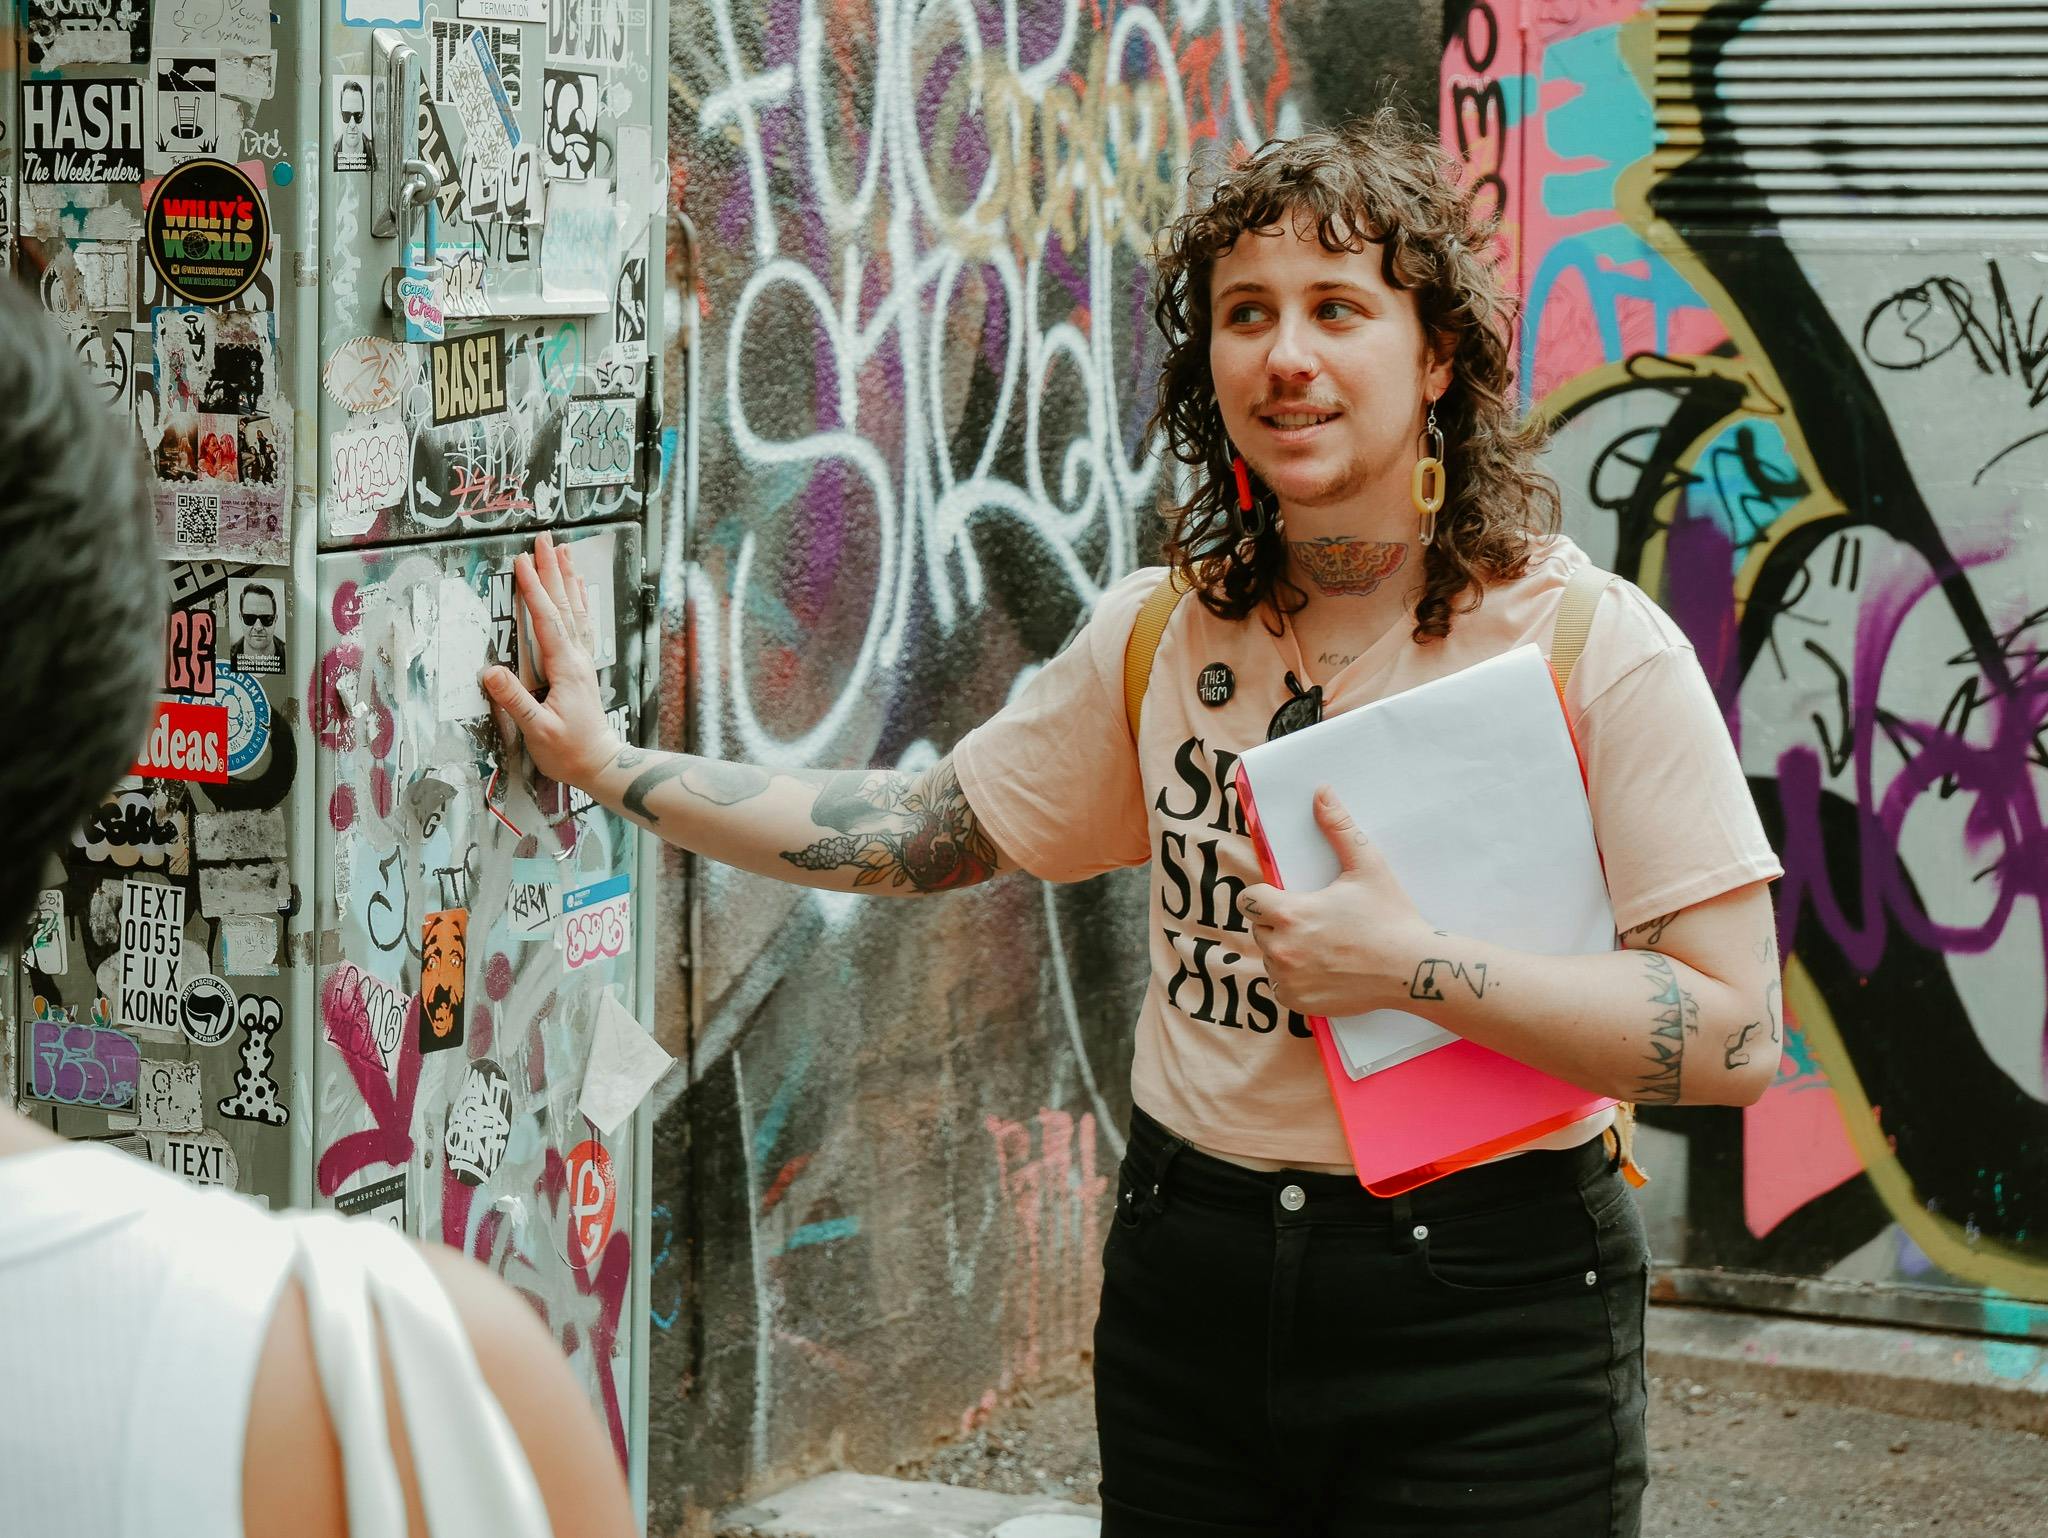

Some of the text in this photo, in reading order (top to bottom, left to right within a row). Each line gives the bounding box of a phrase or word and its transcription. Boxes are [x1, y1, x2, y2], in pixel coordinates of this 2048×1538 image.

[479, 1, 529, 17] TERMINATION
[23, 84, 141, 150] HASH
[23, 152, 141, 183] The WeekEnders
[163, 195, 253, 231] WILLY'S
[162, 229, 253, 261] WORLD
[433, 336, 506, 421] BASEL
[1200, 686, 1228, 700] THEM
[1204, 670, 1226, 684] THEY
[126, 884, 182, 921] TEXT
[124, 919, 181, 957] 0055
[121, 988, 178, 1027] KONG
[216, 984, 234, 1007] ACTION
[194, 1031, 220, 1042] SYDNEY
[168, 1142, 223, 1179] TEXT
